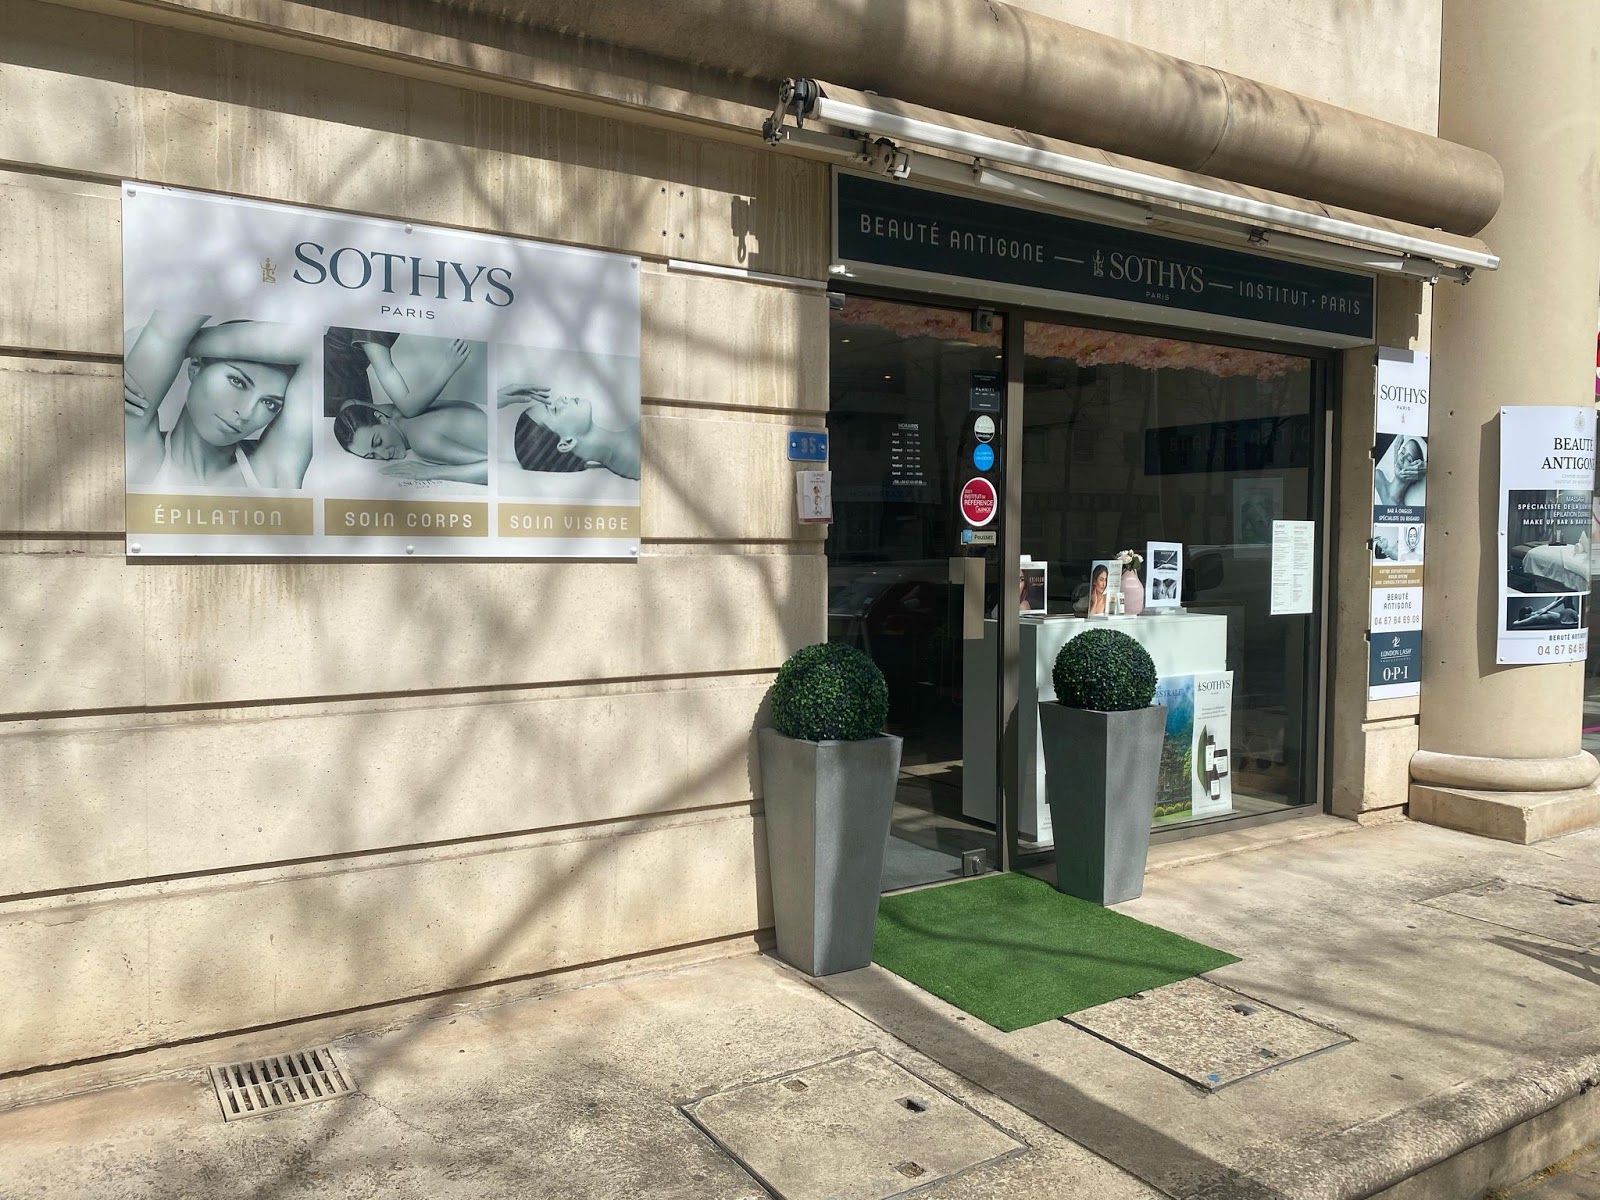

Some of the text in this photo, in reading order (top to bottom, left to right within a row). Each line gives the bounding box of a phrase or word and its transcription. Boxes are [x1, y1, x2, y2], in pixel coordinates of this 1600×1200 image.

[860, 213, 1044, 263] BEAUTÉ ANTIGONE
[293, 241, 515, 307] SOTHYS
[1109, 252, 1204, 293] SOTHYS
[1145, 291, 1170, 301] PARIS
[1239, 281, 1360, 315] INSTITUT PARIS
[381, 305, 435, 320] PARIS
[1380, 384, 1427, 405] SOTHYS
[1517, 502, 1561, 510] SPÉCIALISTE
[154, 504, 282, 526] ÉPILATION
[345, 511, 473, 528] SOIN CORPS
[510, 515, 629, 531] SOIN VISAGE
[1387, 592, 1409, 601] BEAUTÉ
[1383, 602, 1412, 610] ANTIGONE
[1374, 617, 1382, 626] 04
[1384, 616, 1391, 625] 67
[1549, 633, 1570, 641] BEAUTÉ
[1380, 650, 1399, 658] LONDON
[1537, 645, 1550, 656] 04
[1554, 644, 1565, 655] 67
[1568, 644, 1577, 654] 64
[1202, 680, 1231, 692] SOTHYS
